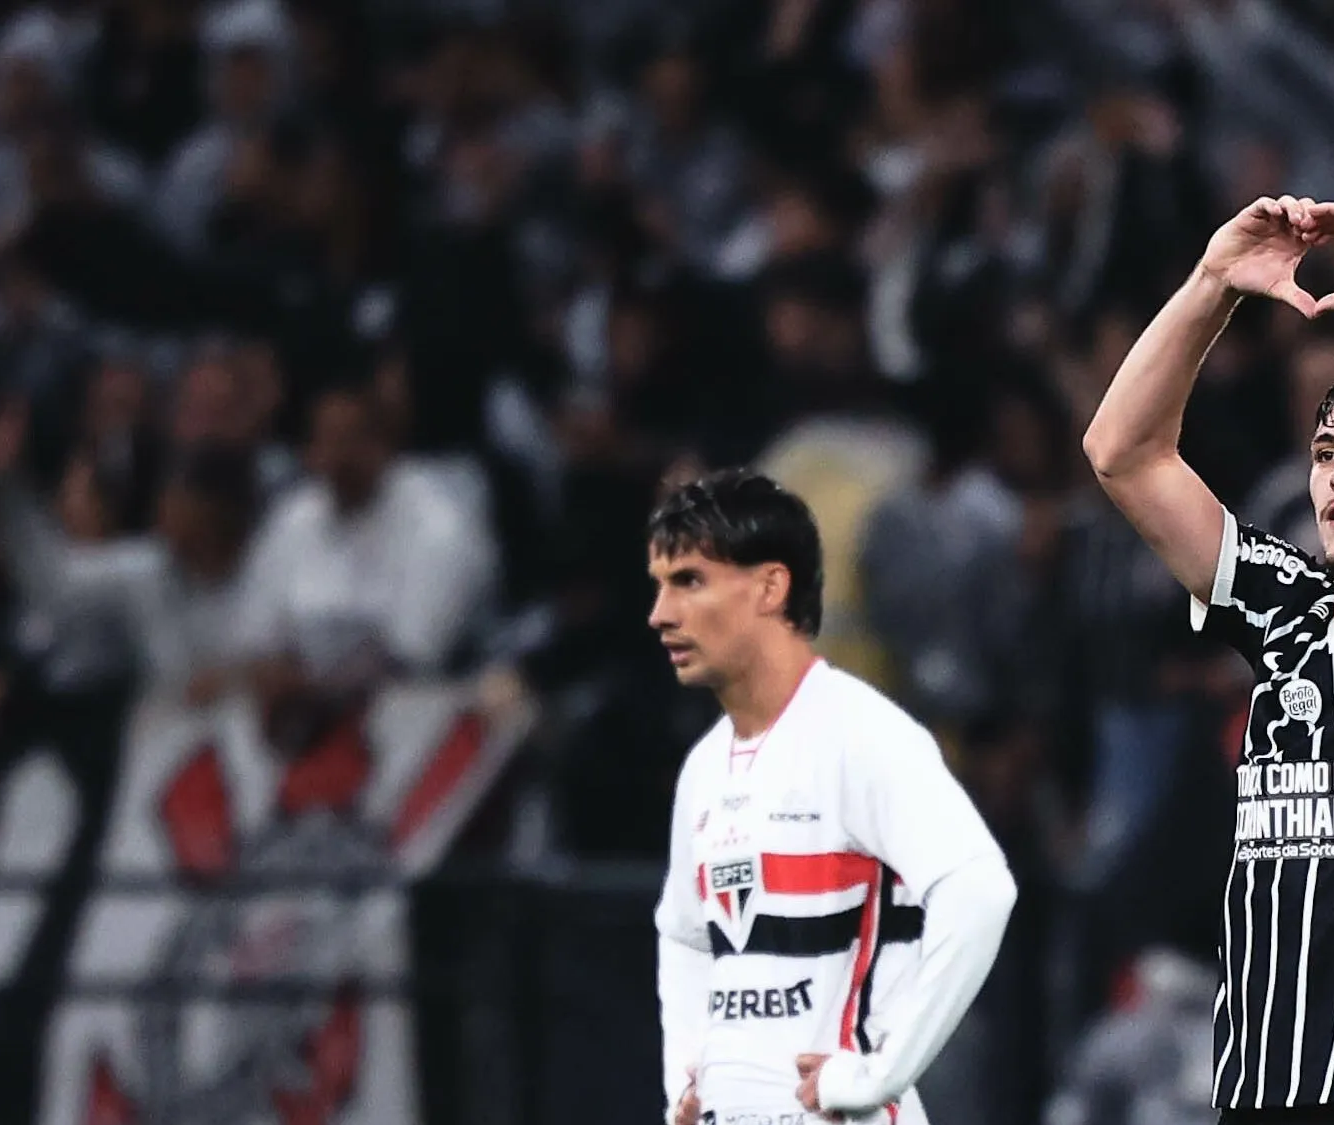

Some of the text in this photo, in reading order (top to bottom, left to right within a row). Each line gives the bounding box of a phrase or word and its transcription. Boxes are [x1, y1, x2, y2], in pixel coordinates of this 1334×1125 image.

[1282, 685, 1315, 703] Broto
[1288, 697, 1317, 716] Legal
[1267, 761, 1329, 795] COMO
[708, 978, 814, 1020] PERBET
